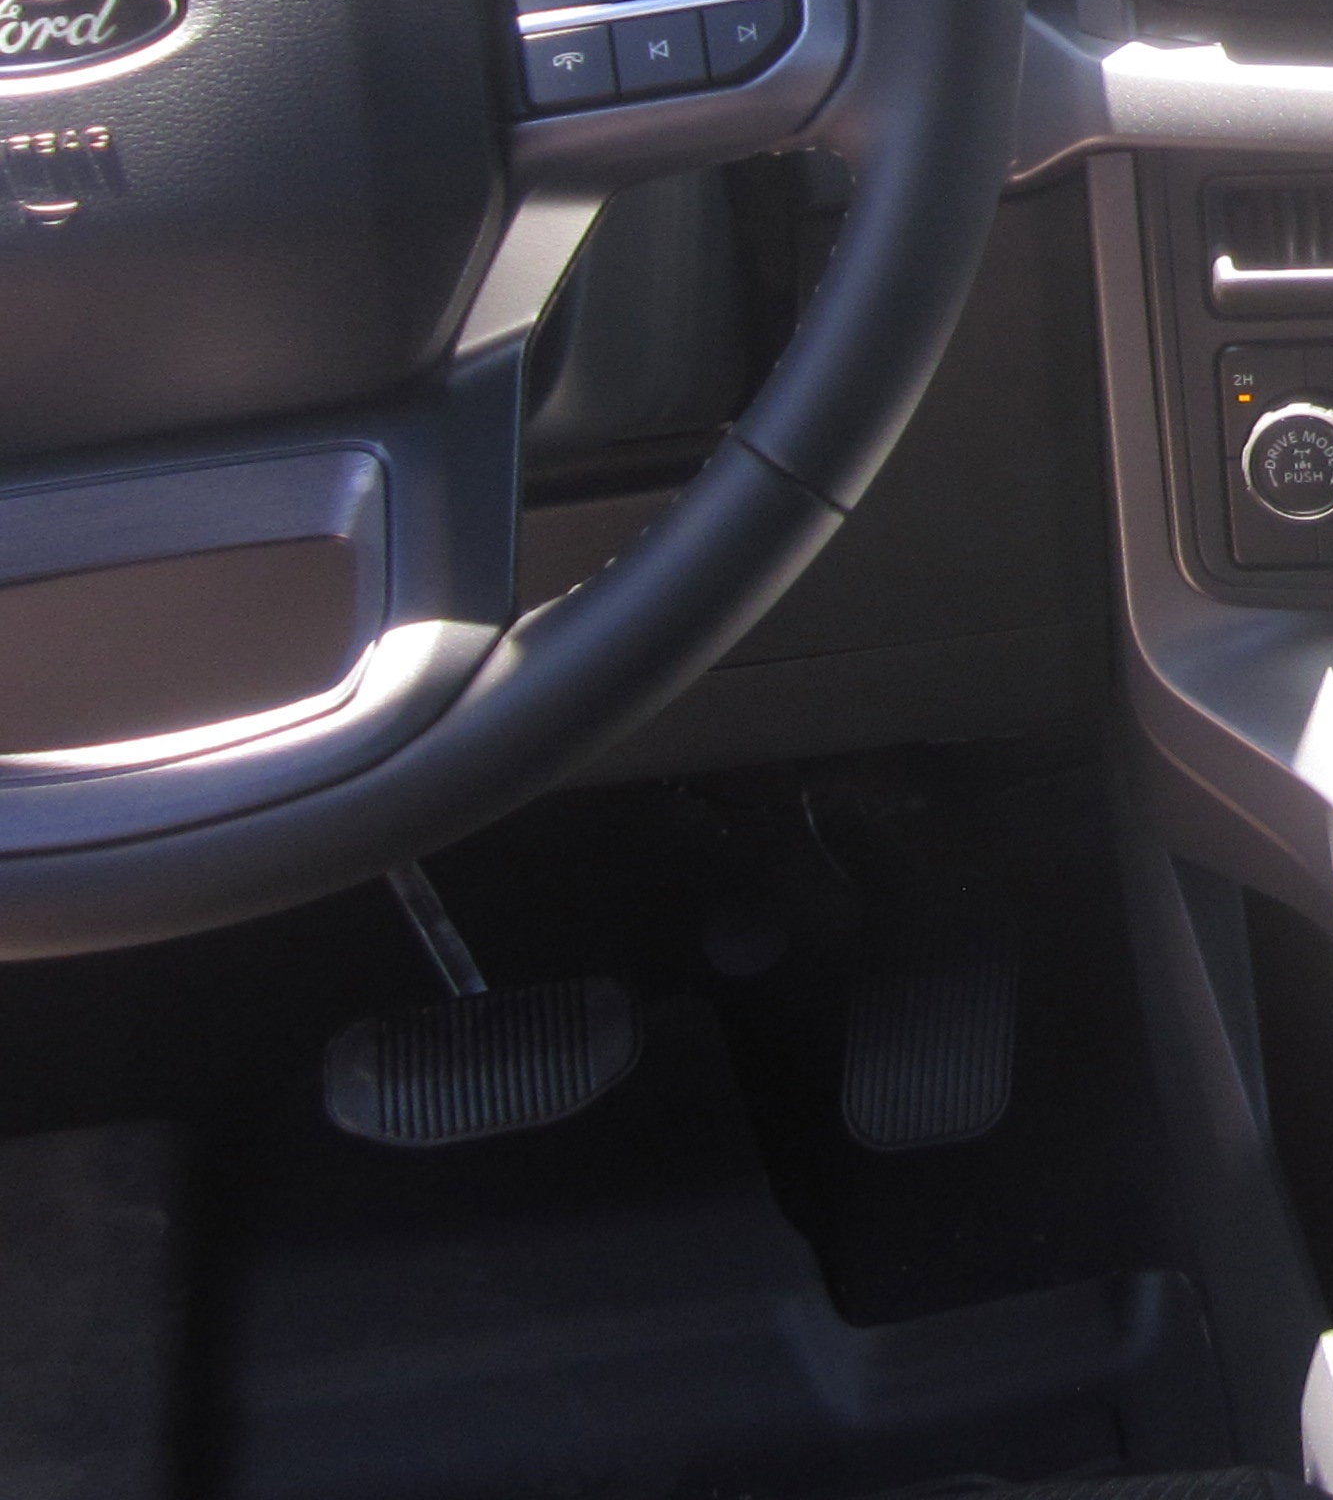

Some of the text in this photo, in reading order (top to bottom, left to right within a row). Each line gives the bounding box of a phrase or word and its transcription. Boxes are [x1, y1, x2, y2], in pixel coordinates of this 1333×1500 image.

[1233, 374, 1253, 386] 2H
[1264, 431, 1297, 470] DRIVE
[1284, 472, 1324, 484] PUSH
